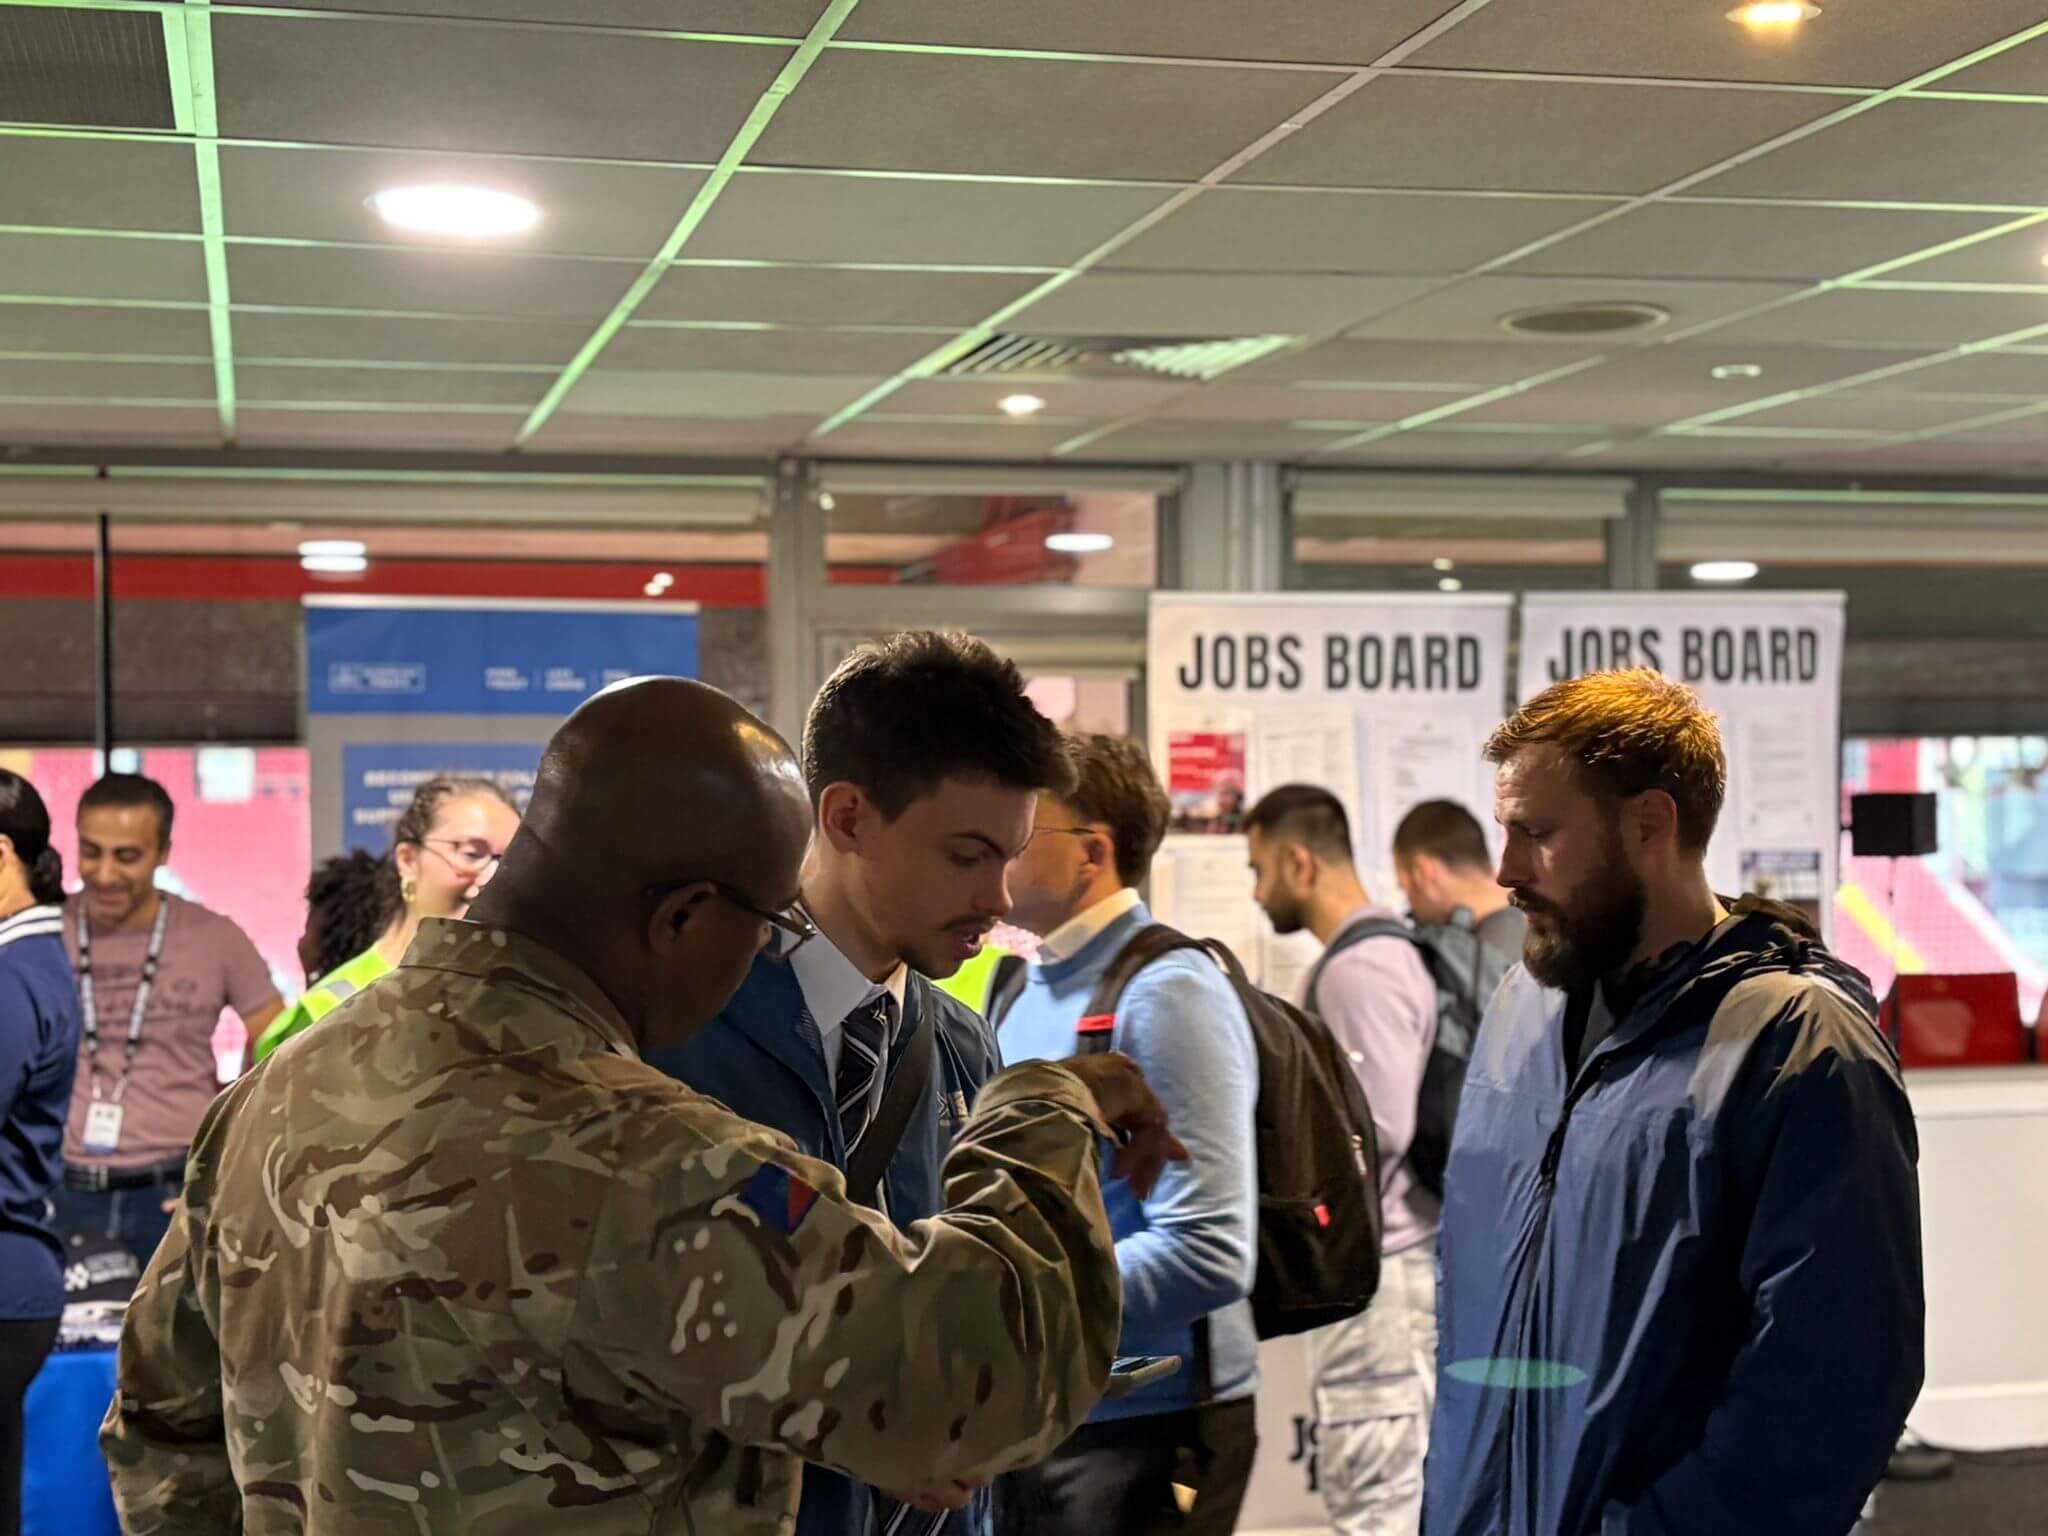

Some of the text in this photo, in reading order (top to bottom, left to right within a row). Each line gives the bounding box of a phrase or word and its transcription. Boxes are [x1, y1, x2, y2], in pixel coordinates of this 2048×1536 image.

[1178, 633, 1481, 691] JOBS BOARD
[1681, 627, 1818, 682] BOARD
